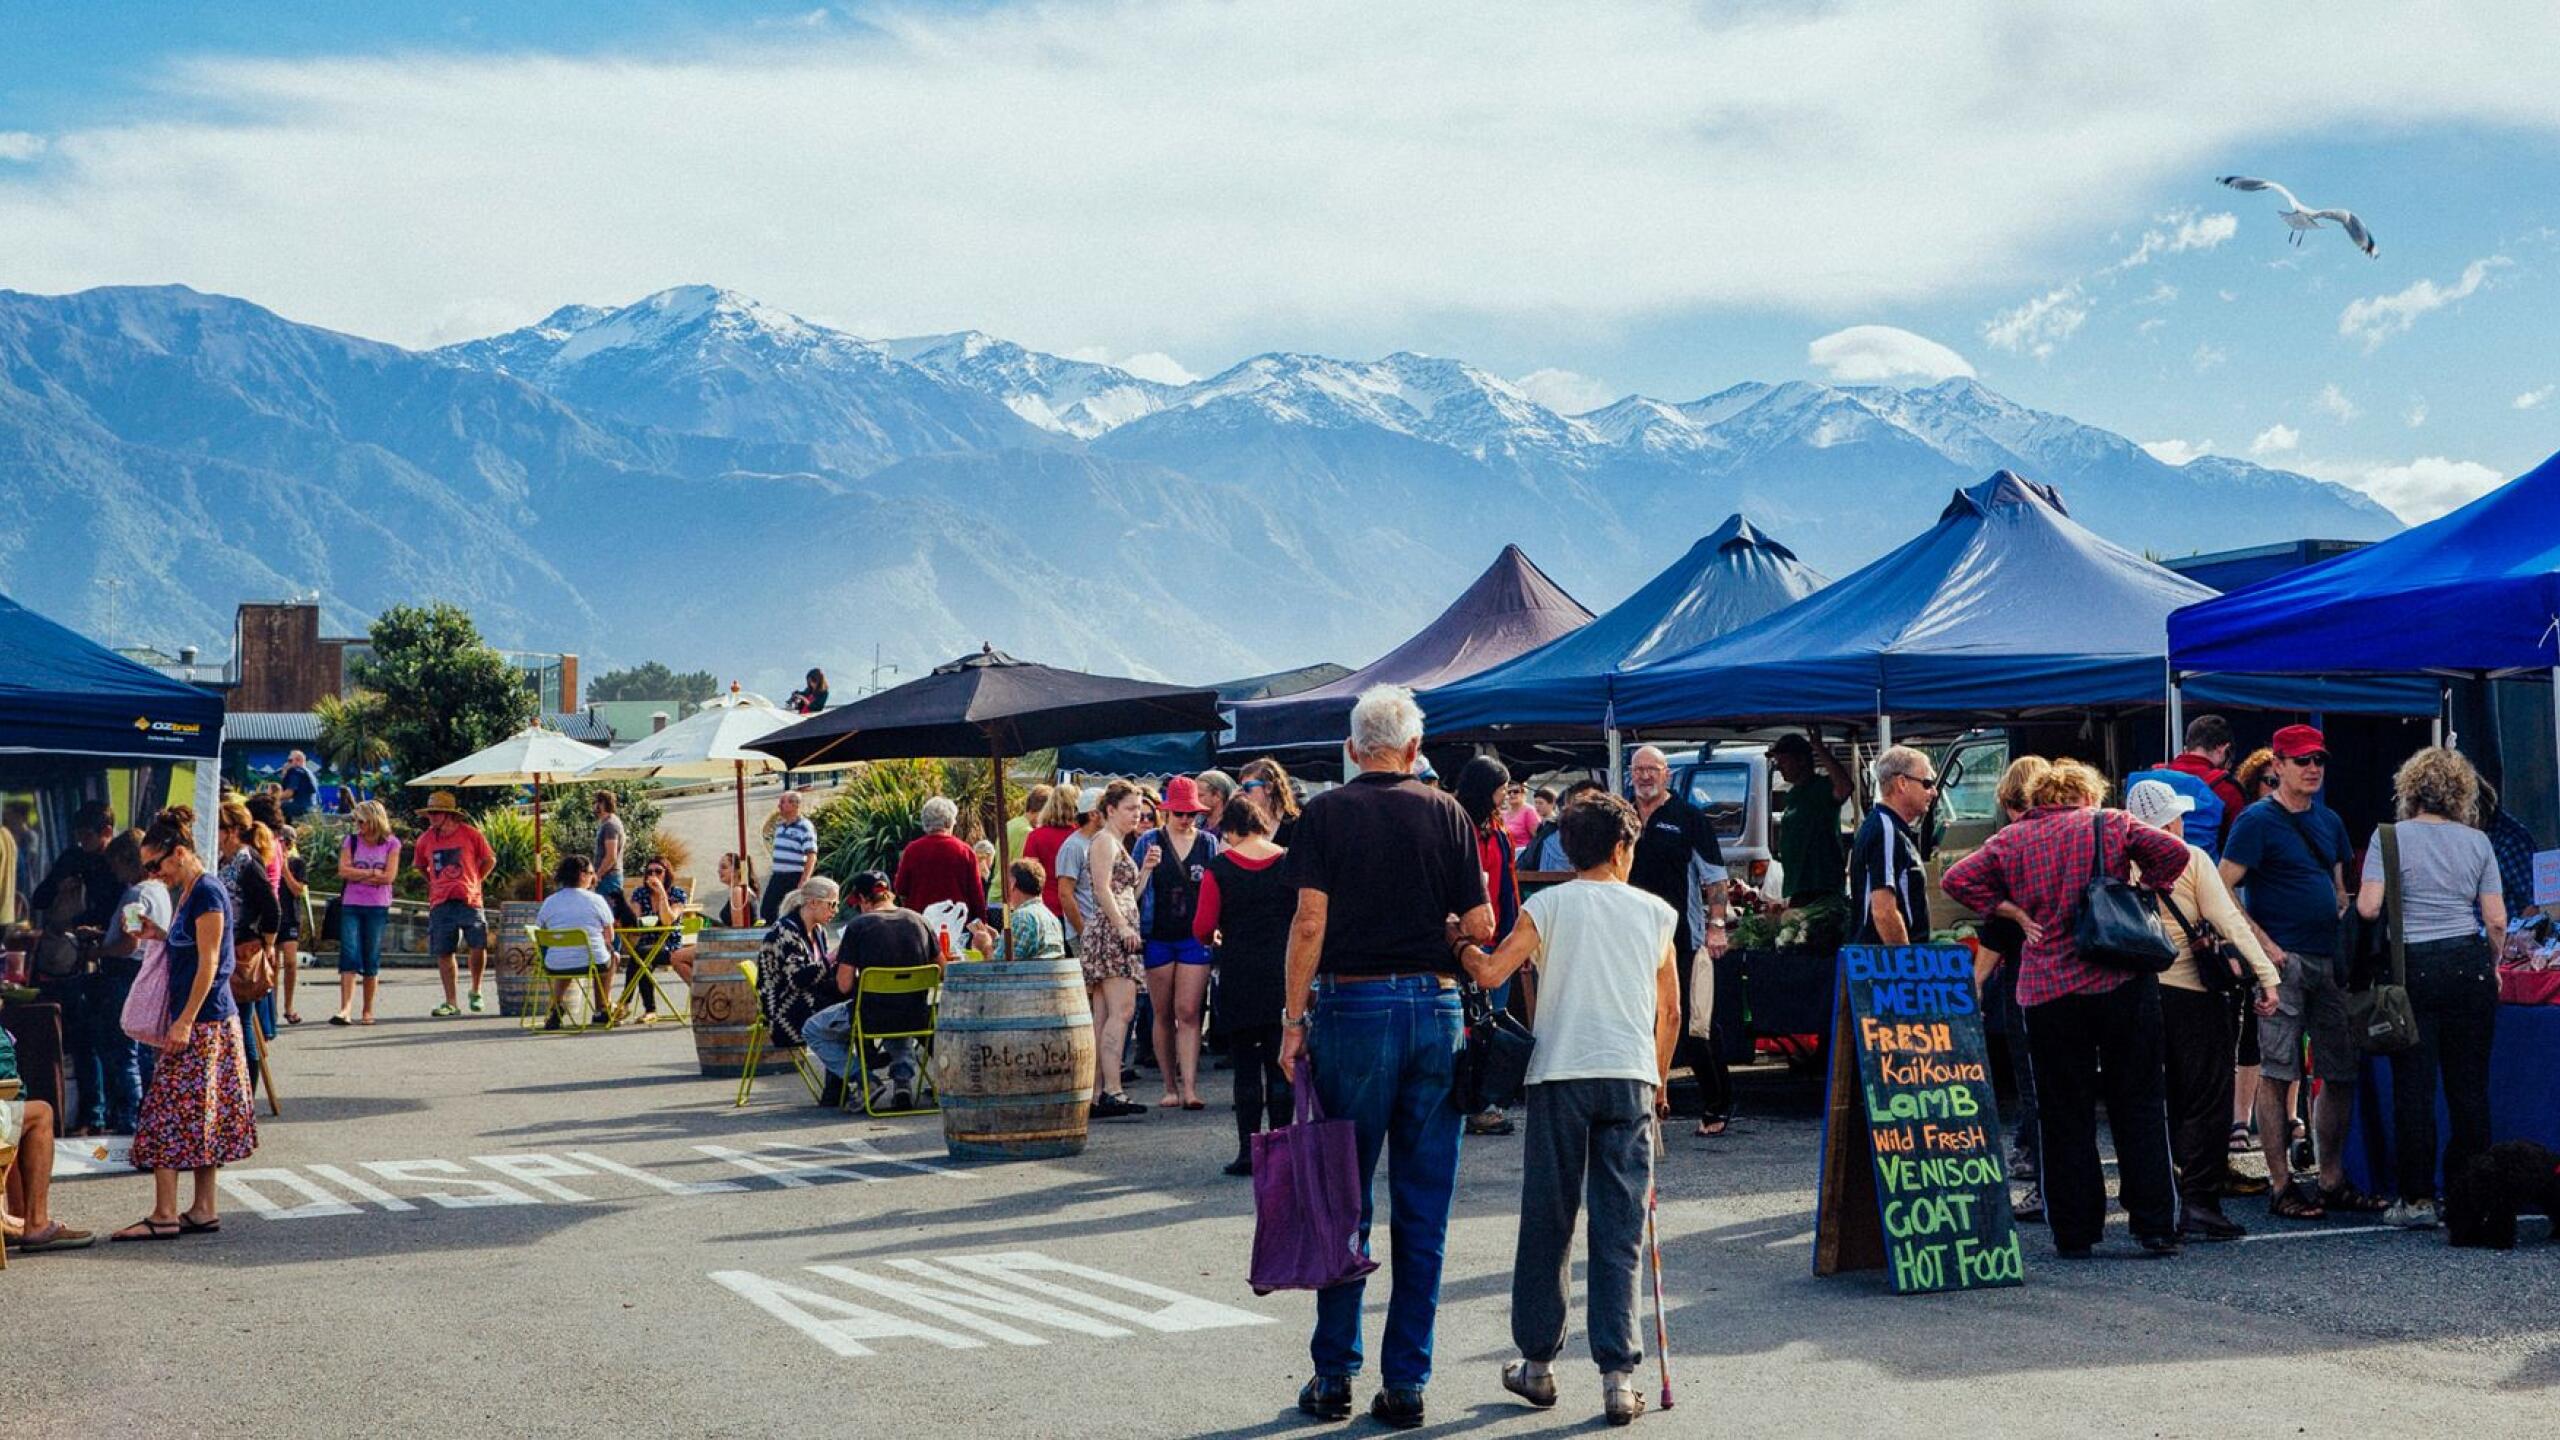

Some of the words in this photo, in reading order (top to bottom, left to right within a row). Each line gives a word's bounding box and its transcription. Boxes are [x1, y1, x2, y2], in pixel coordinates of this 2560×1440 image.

[1873, 982, 1975, 1015] MEATS
[1861, 1018, 1952, 1053] FRESH
[980, 1045, 1035, 1068] Peter
[1872, 1125, 1914, 1152] Wild
[1923, 1124, 1986, 1150] FRESH
[216, 1139, 980, 1220] DISPLAY
[1877, 1154, 2003, 1194] VENISON
[1885, 1194, 1976, 1237] GOAT
[1894, 1241, 1948, 1289] HOT
[1956, 1229, 2023, 1287] Food
[707, 1252, 1281, 1356] AND
